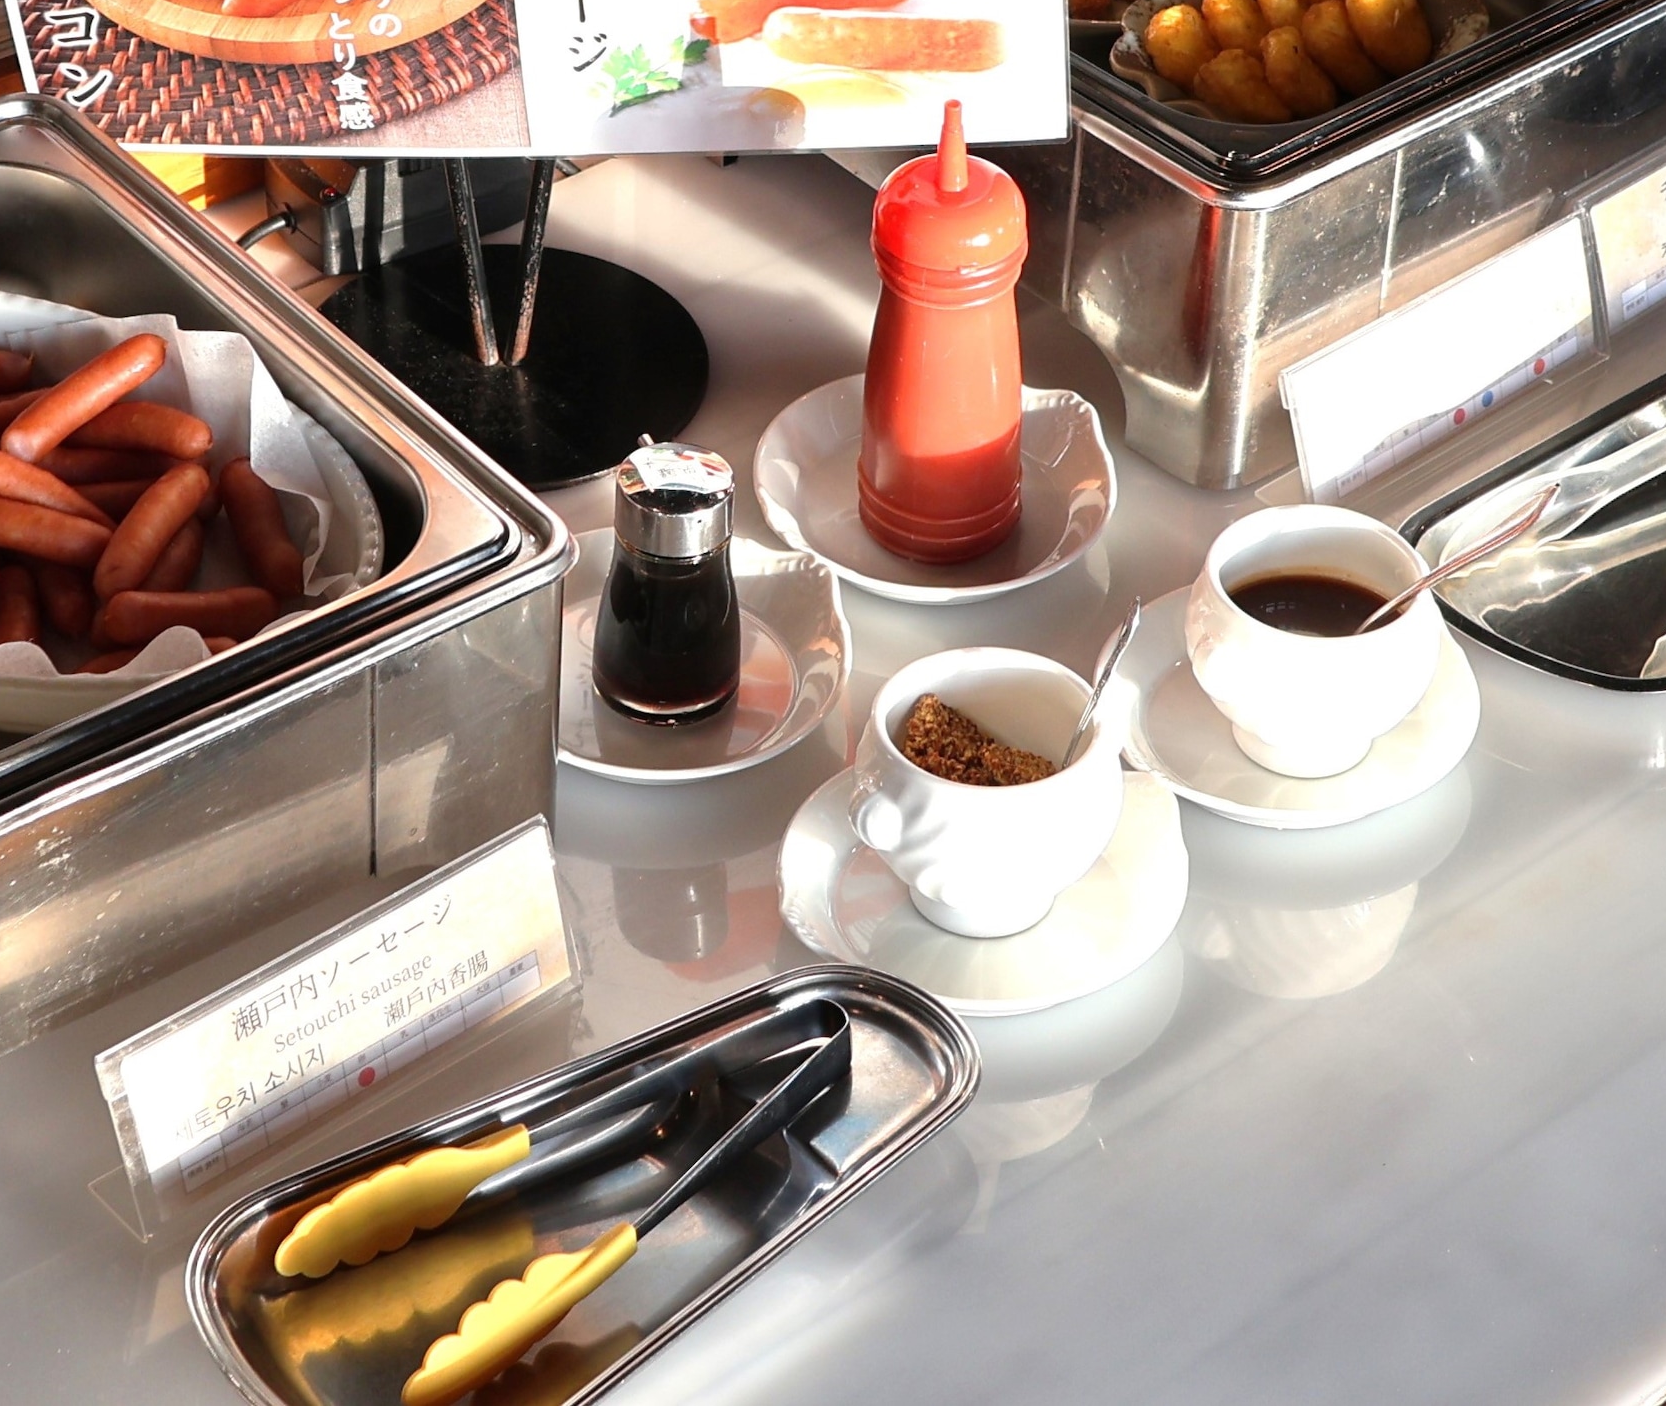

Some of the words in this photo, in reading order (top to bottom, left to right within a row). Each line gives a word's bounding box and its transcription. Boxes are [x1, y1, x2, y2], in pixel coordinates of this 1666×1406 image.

[230, 893, 453, 1043] 瀬戸内ソーセージ
[273, 998, 357, 1055] Setouchi
[361, 952, 433, 1006] sausage
[264, 1043, 326, 1095] 소시지
